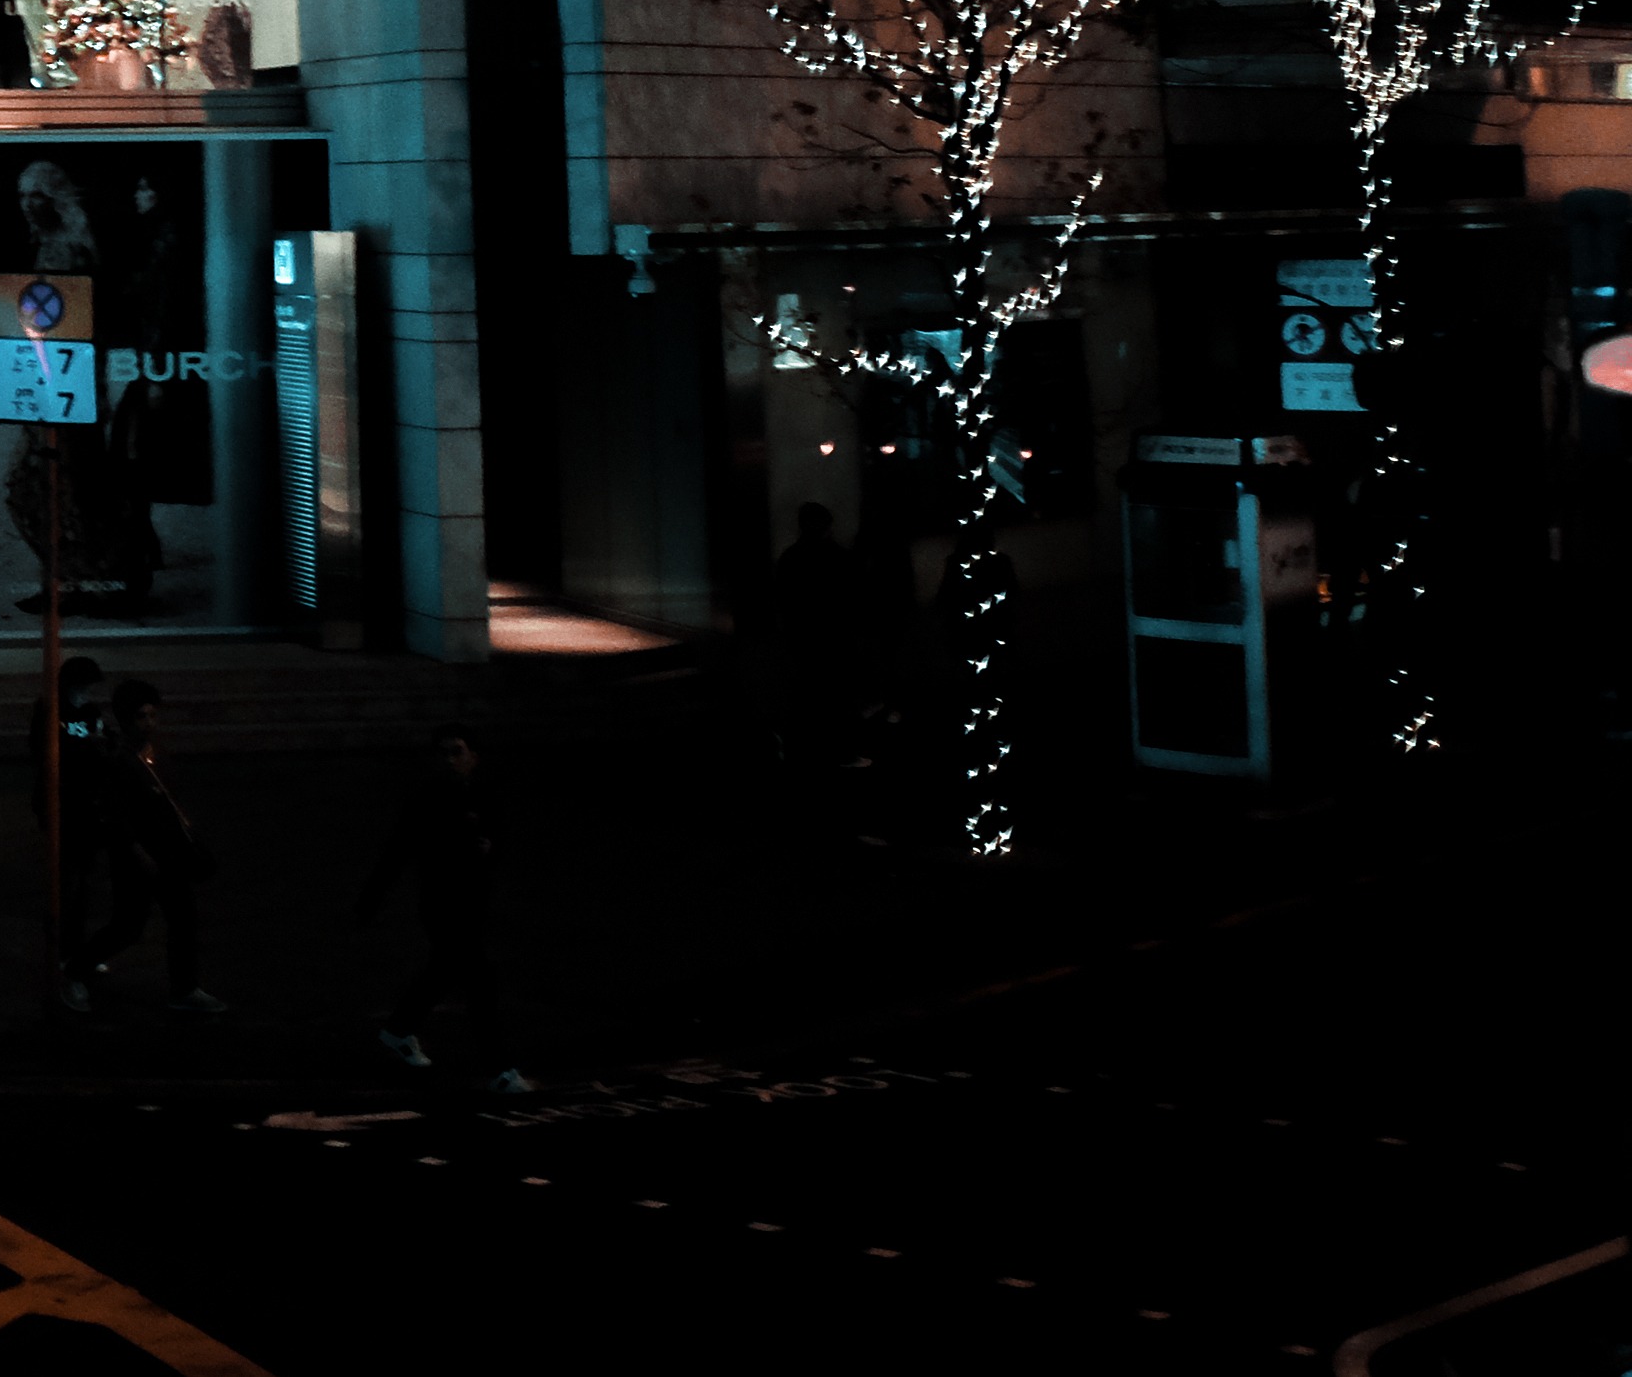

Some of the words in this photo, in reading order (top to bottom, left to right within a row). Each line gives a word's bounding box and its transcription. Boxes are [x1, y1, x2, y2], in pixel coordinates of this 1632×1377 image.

[57, 348, 74, 374] 7
[57, 391, 75, 417] 7
[719, 1069, 940, 1103] LOOK
